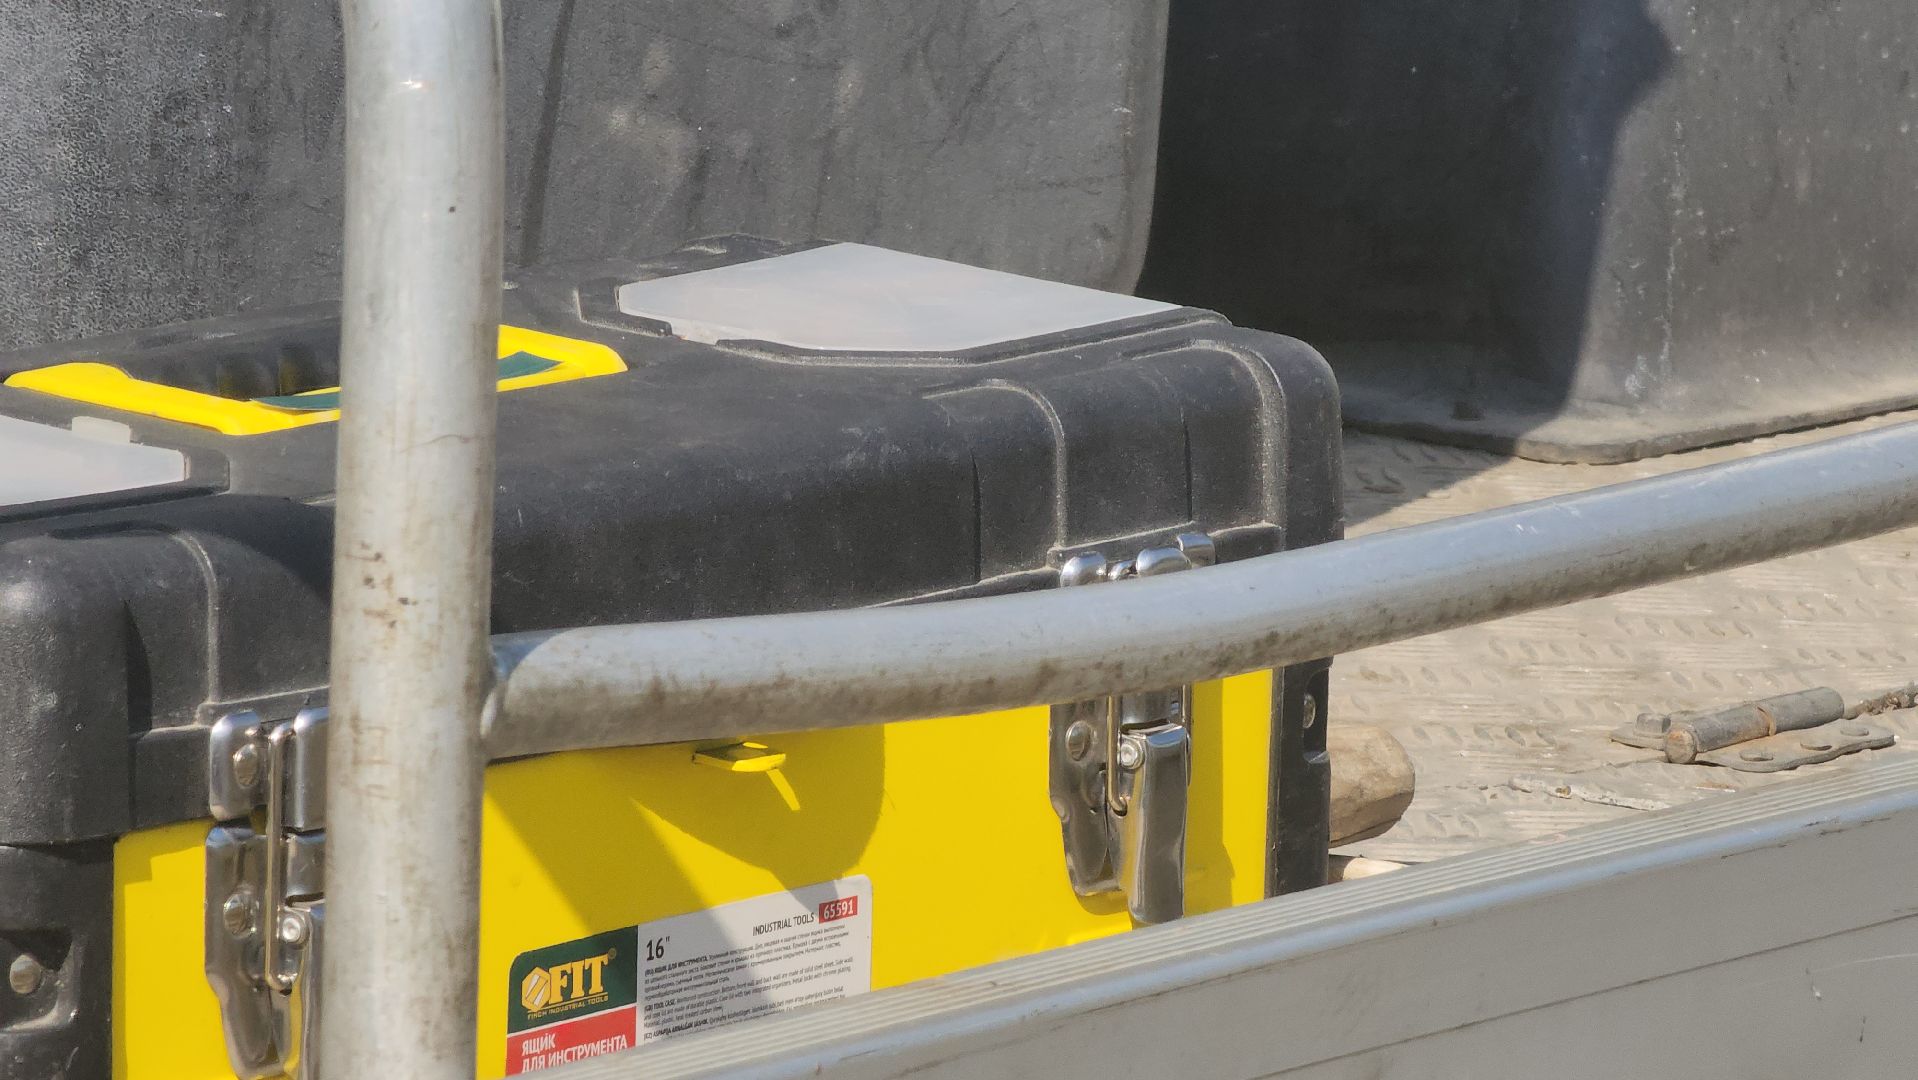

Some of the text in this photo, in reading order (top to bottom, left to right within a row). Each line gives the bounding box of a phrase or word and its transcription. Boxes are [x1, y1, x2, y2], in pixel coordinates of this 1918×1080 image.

[823, 898, 854, 920] 65591
[753, 912, 815, 936] INDUSTRIAL TOOLS
[646, 936, 670, 961] 16"
[549, 954, 608, 1004] FIT
[522, 1034, 627, 1074] ДЛЯ ИНСТРУМЕНТА
